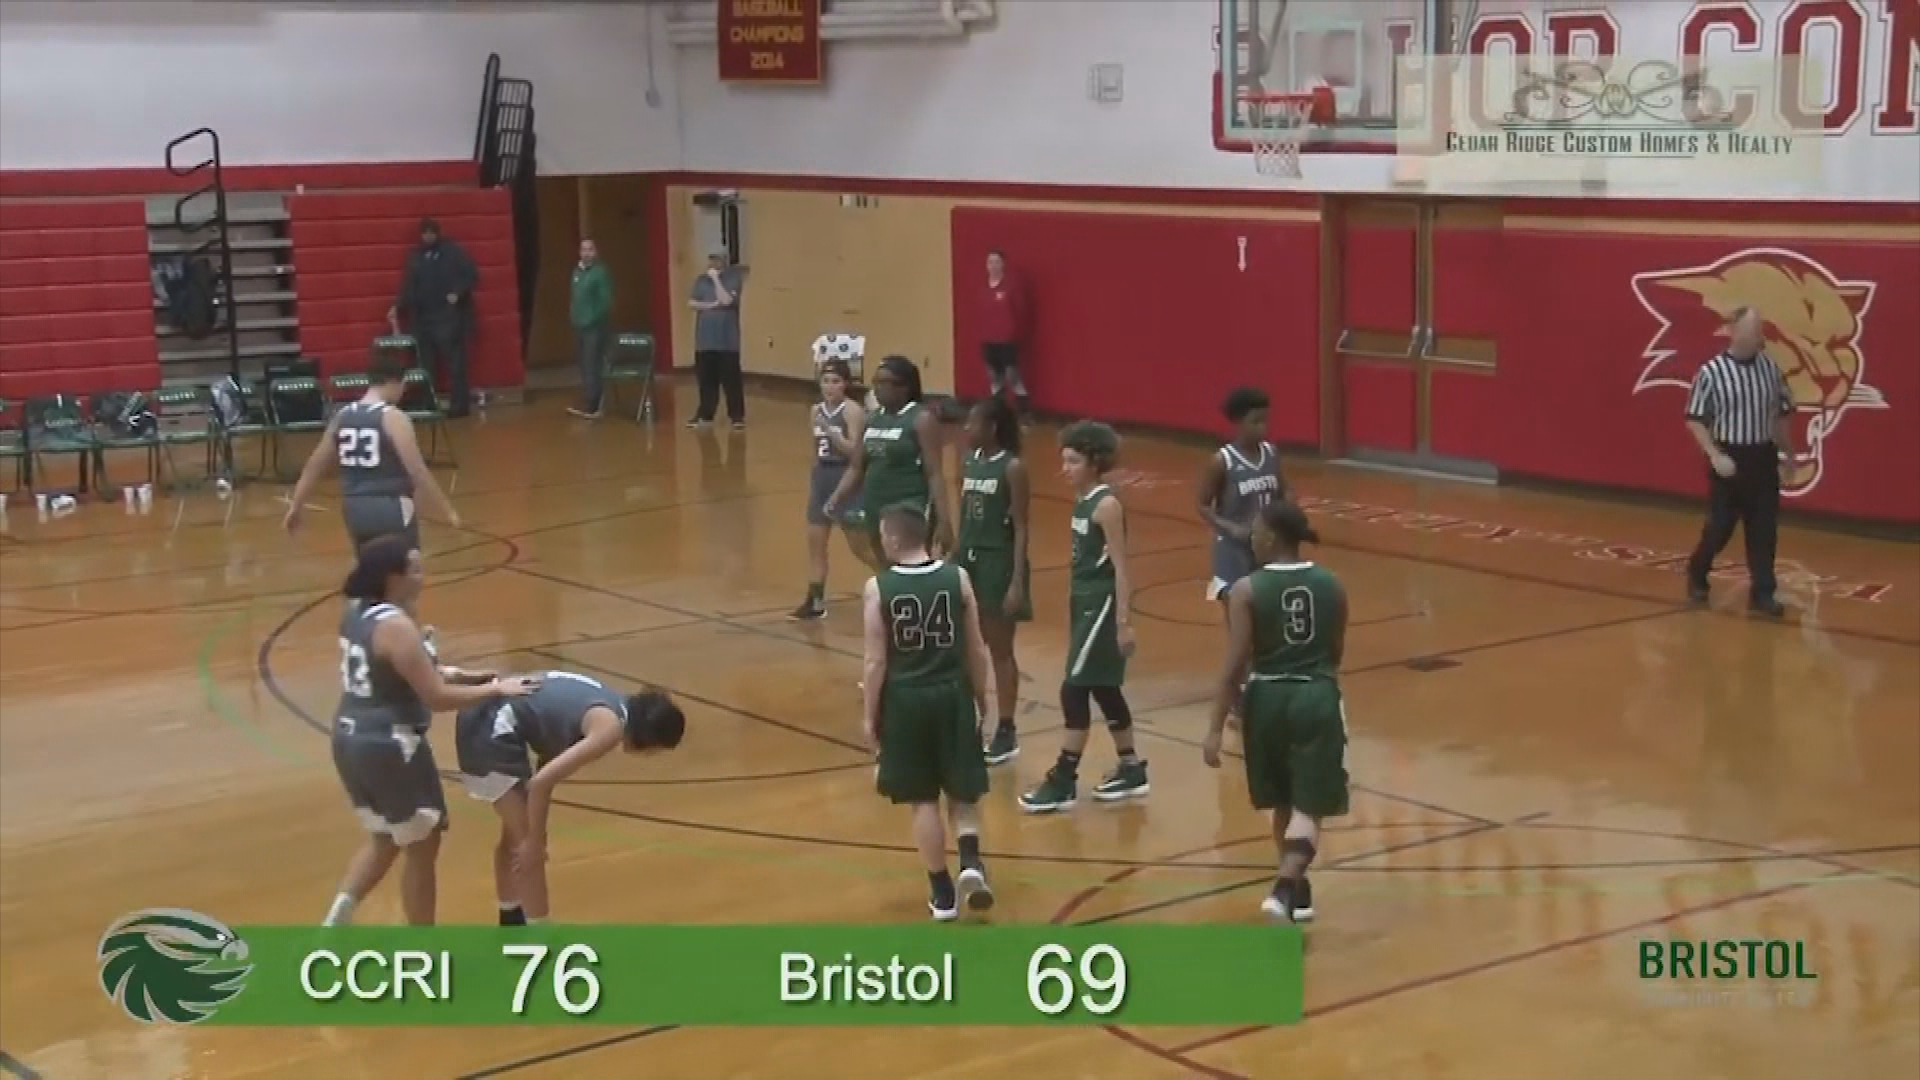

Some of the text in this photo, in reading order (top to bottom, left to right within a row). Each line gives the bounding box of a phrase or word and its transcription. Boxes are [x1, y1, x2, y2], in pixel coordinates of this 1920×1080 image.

[729, 25, 805, 42] CHAMPIONS
[337, 427, 381, 467] 23
[890, 590, 955, 651] 24
[1280, 585, 1315, 646] 3
